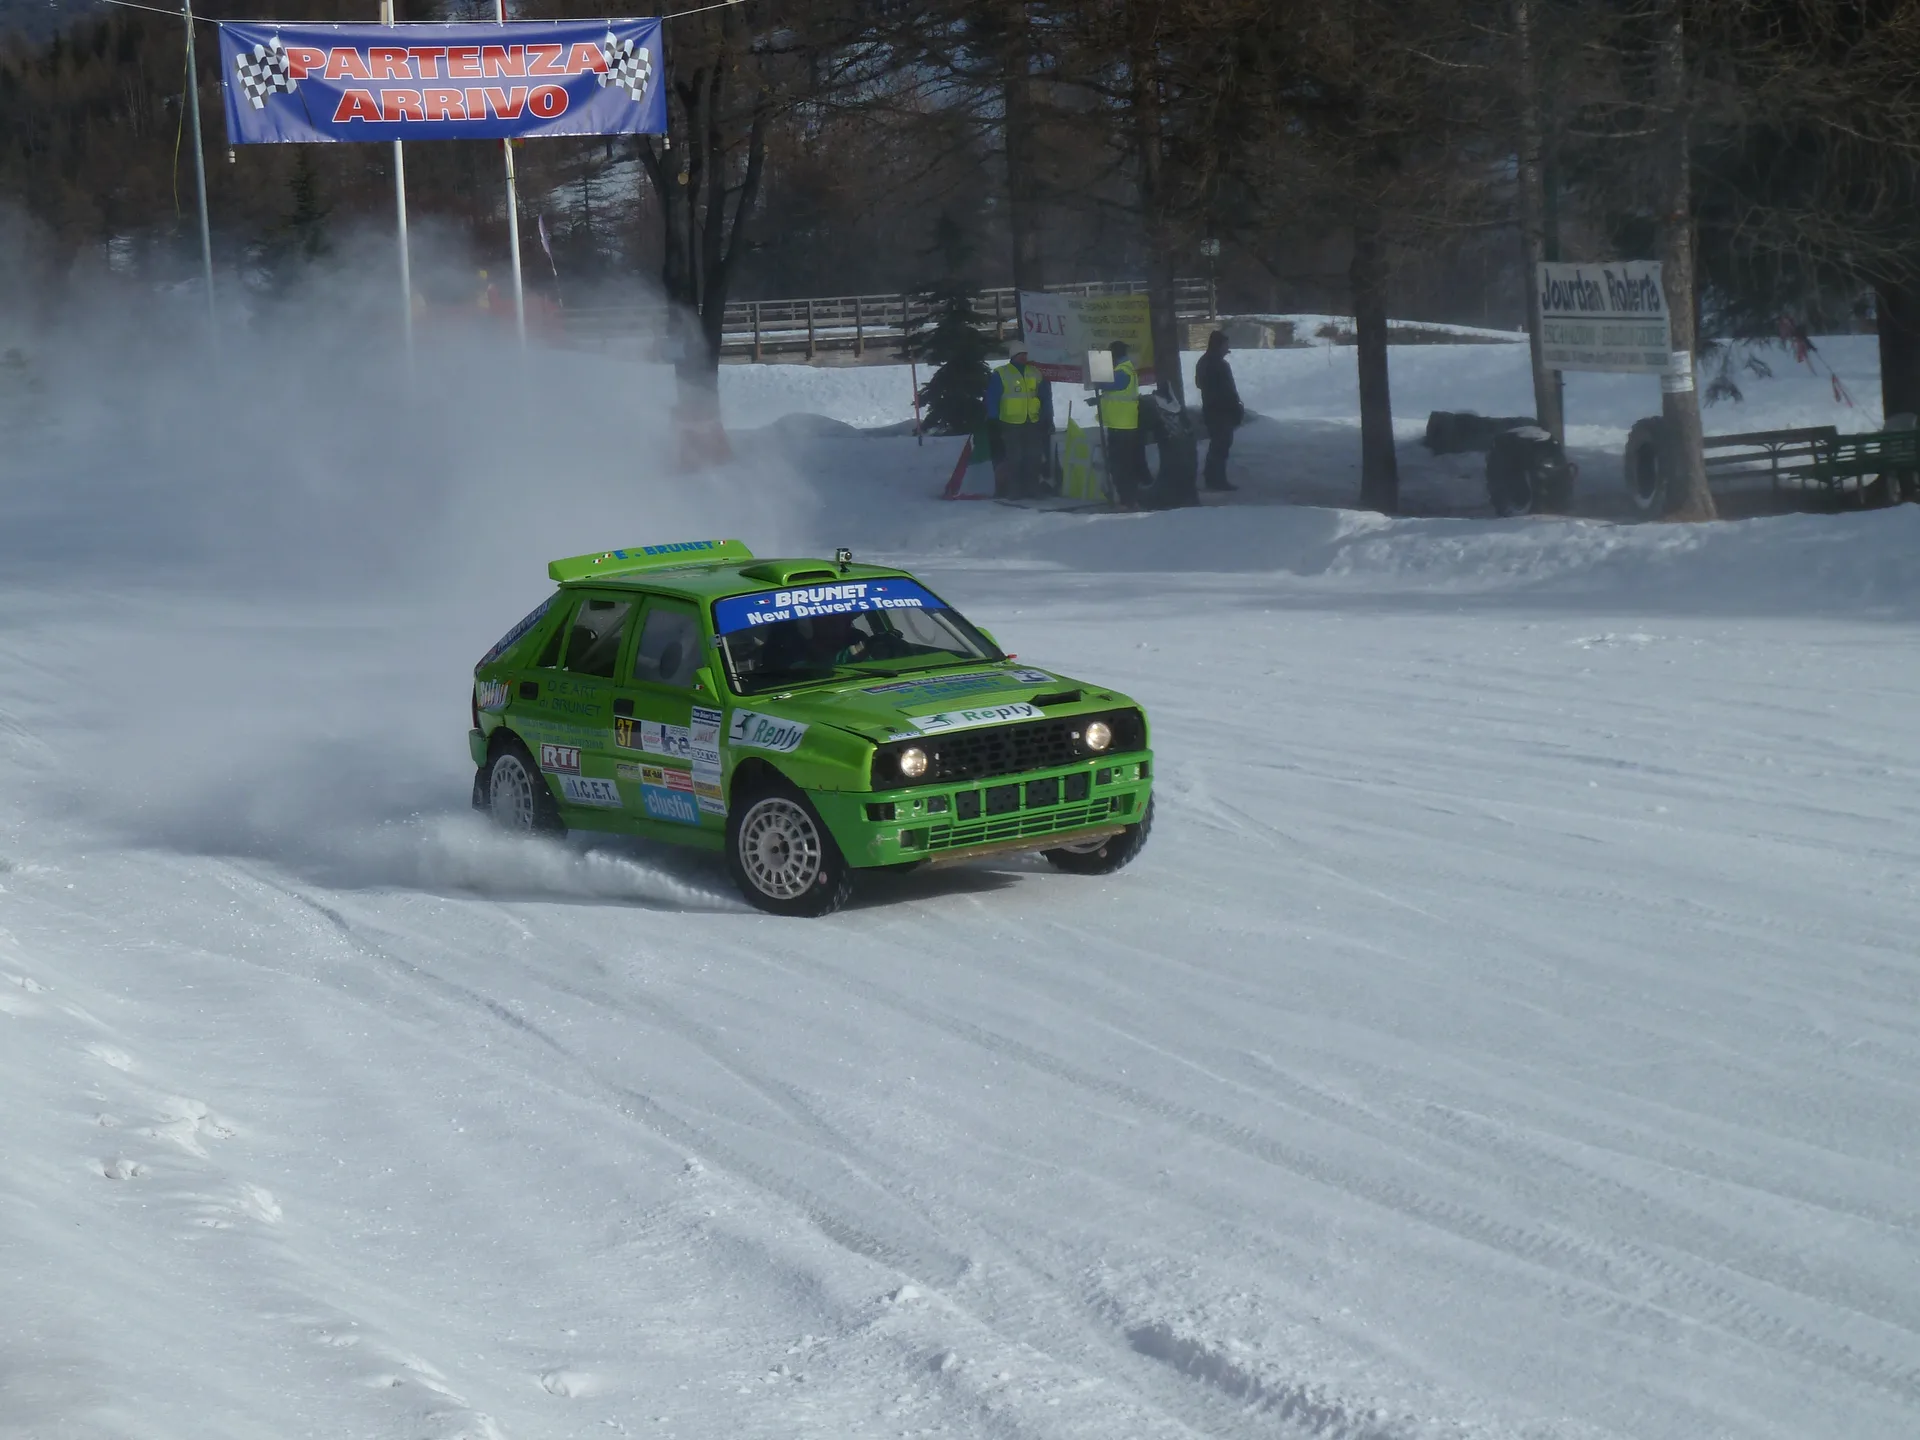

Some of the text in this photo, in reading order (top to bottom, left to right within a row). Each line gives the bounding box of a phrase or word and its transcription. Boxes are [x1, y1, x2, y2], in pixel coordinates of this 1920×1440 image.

[285, 42, 610, 80] PARTENZA
[332, 84, 569, 123] ARRIVO
[1542, 268, 1605, 312] Jourdan
[1024, 310, 1067, 336] SELF
[642, 541, 715, 556] BRUNET
[775, 584, 867, 607] BRUNET
[747, 597, 923, 625] New Driver's Team
[552, 697, 601, 717] BRUNET
[961, 704, 1034, 721] Reply
[617, 718, 633, 747] 37
[753, 719, 802, 749] Reply
[543, 745, 579, 769] RTI
[571, 779, 615, 800] I.C.E.T.
